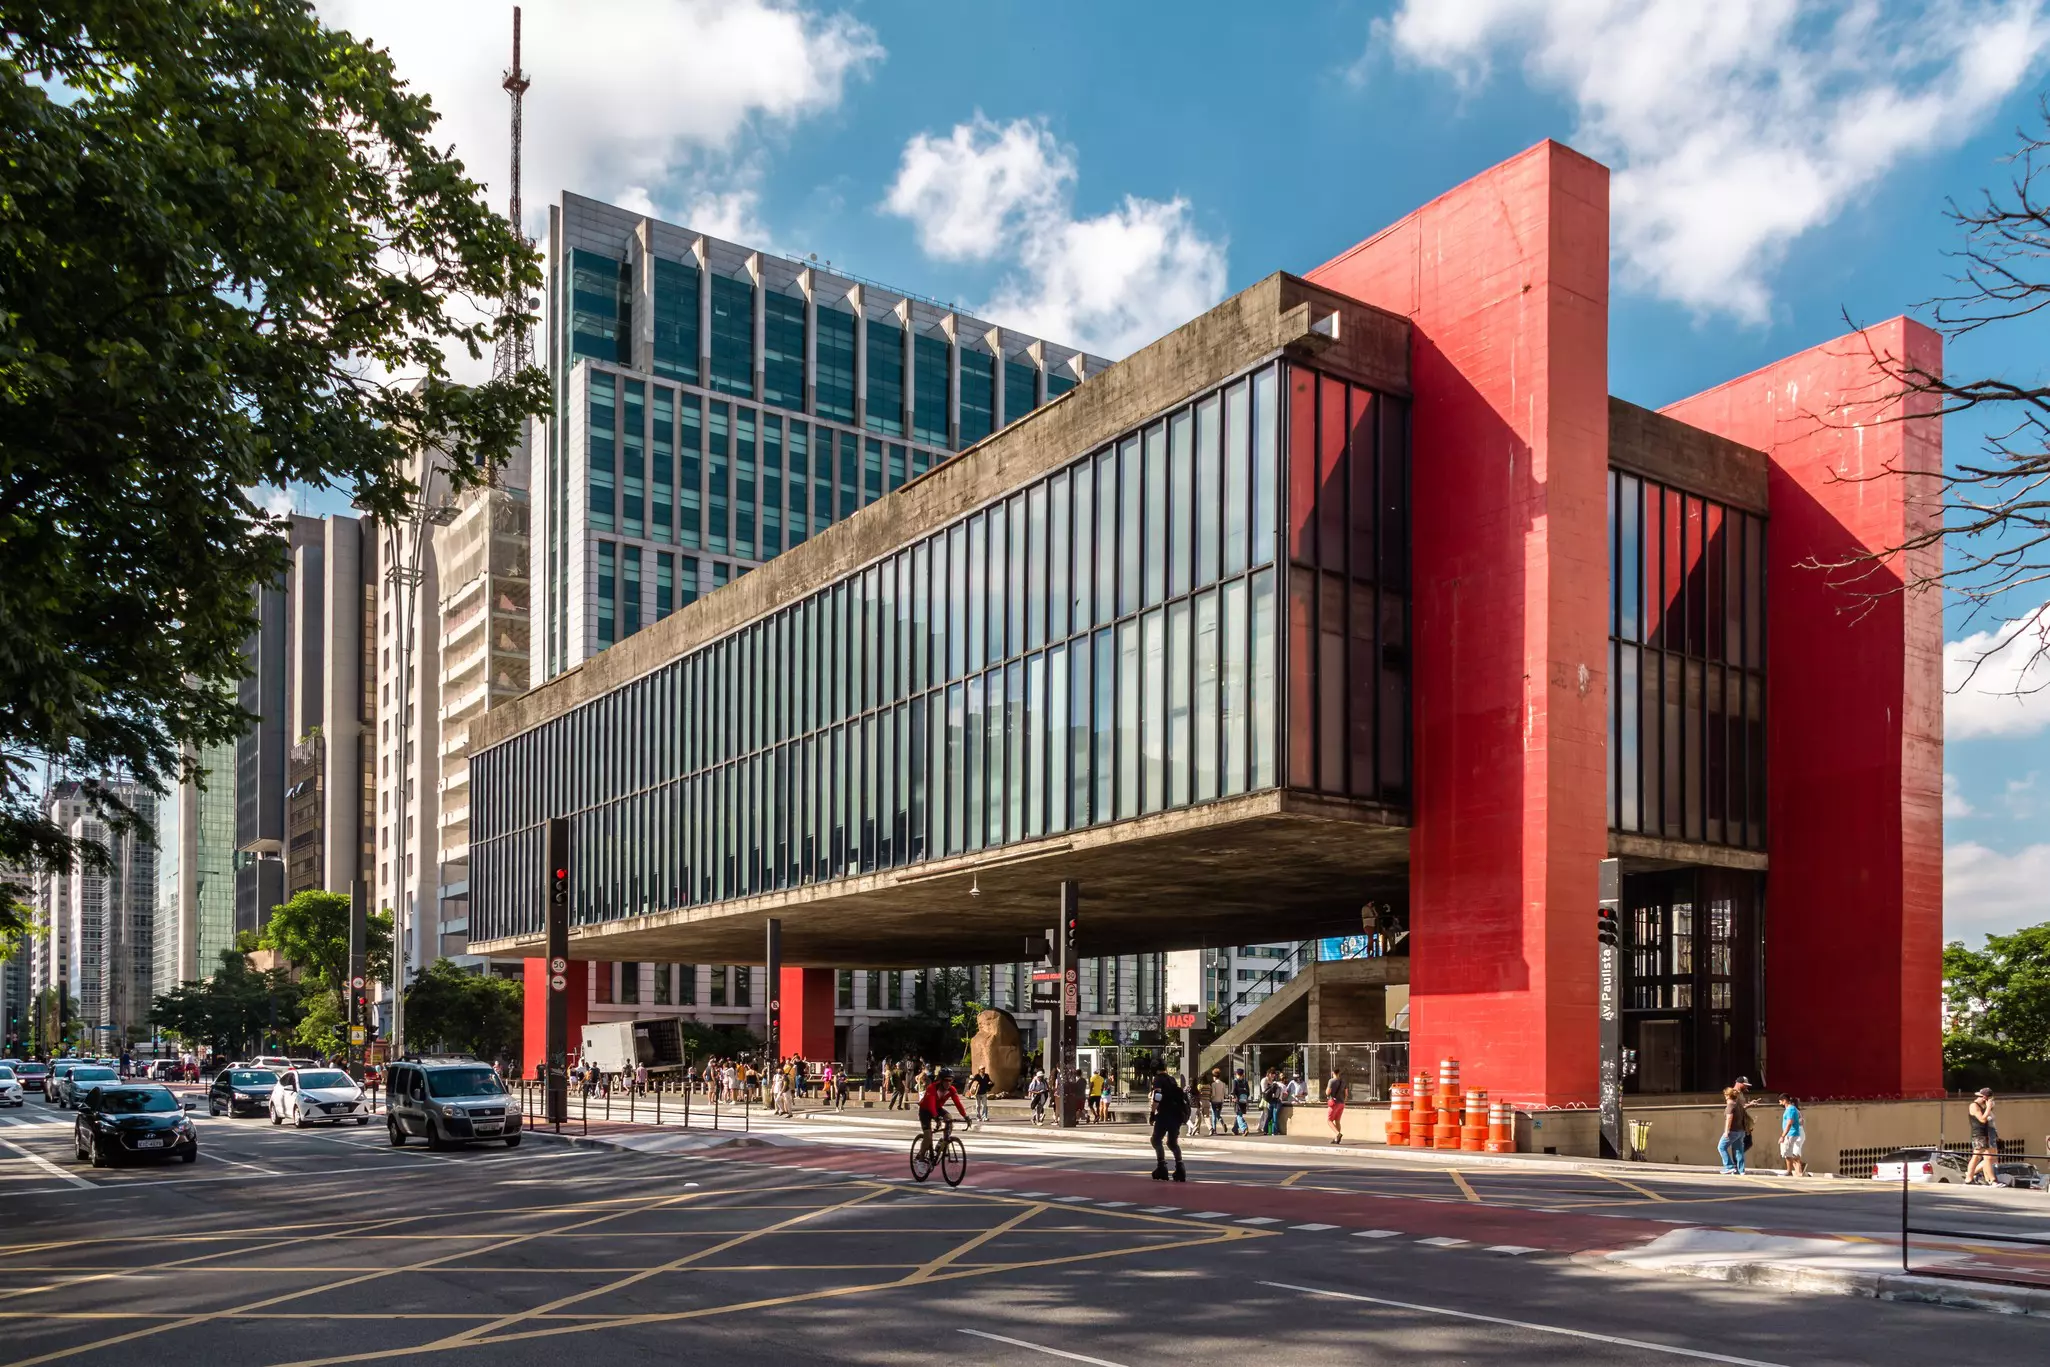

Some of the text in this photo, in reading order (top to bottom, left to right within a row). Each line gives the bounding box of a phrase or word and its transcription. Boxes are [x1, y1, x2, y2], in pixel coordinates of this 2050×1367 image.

[553, 961, 565, 969] 50
[1602, 949, 1612, 1000] Paulista
[1166, 1014, 1196, 1028] MASP
